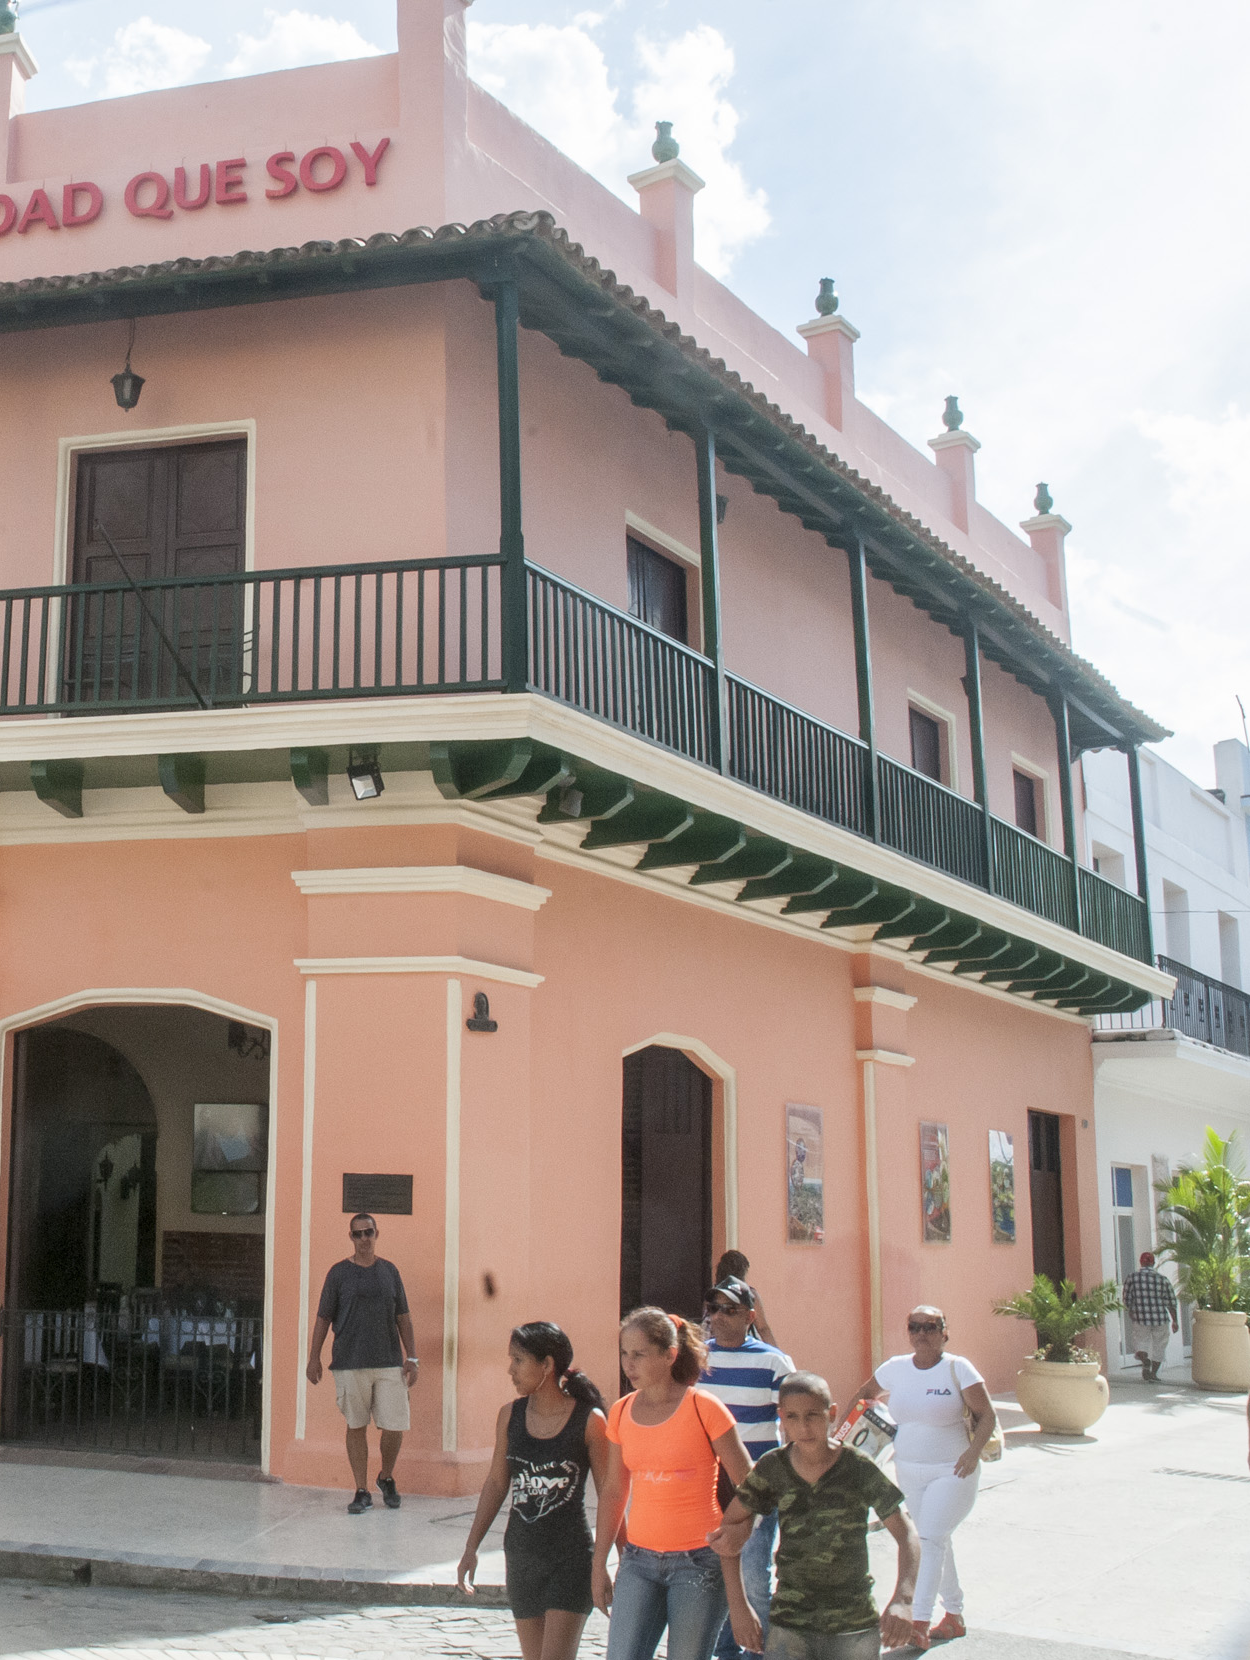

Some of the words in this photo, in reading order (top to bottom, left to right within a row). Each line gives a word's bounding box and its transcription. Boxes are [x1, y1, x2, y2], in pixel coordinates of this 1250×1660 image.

[123, 158, 248, 219] QUE
[264, 138, 392, 201] SOY
[926, 1388, 952, 1396] FILA
[528, 1488, 549, 1496] LOVE
